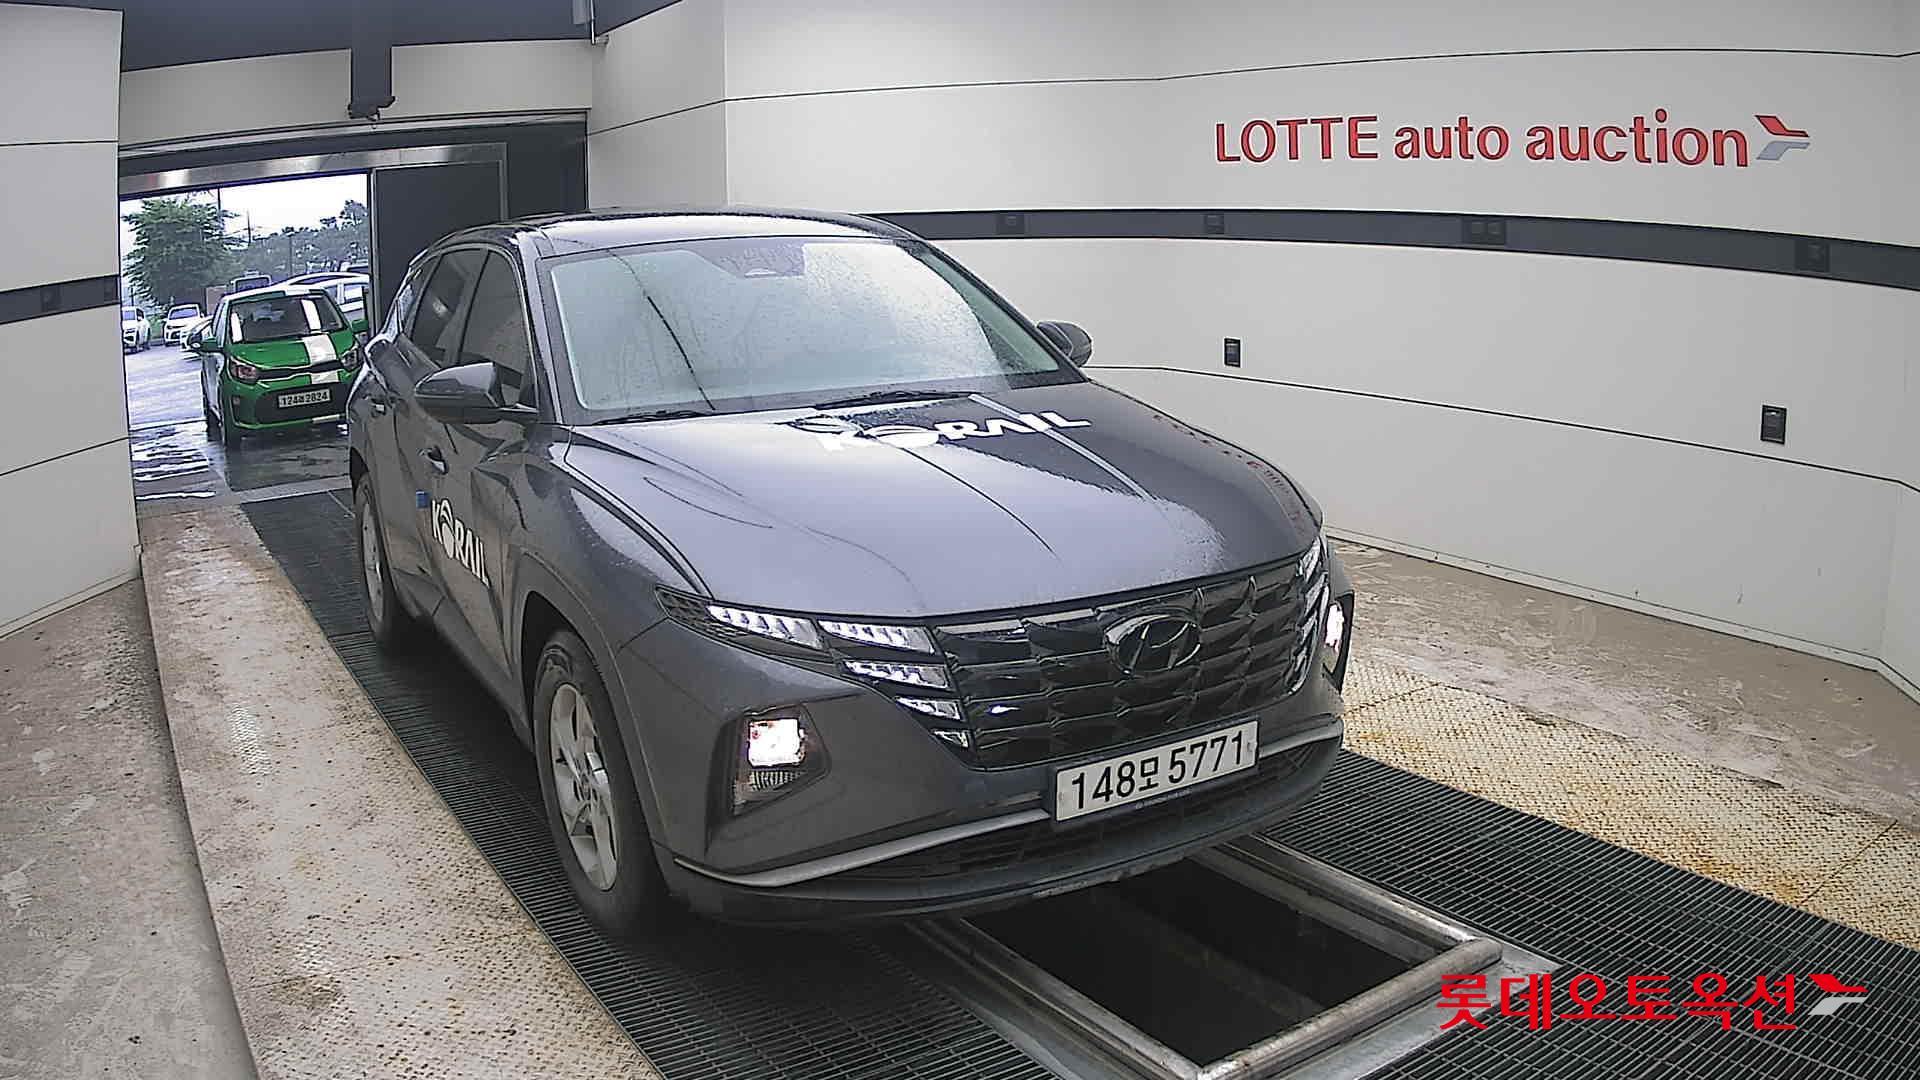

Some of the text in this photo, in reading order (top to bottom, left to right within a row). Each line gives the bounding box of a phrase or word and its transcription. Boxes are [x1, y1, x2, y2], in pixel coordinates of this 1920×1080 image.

[1215, 108, 1748, 167] LOTTE auto auction
[431, 499, 490, 589] KORAIL
